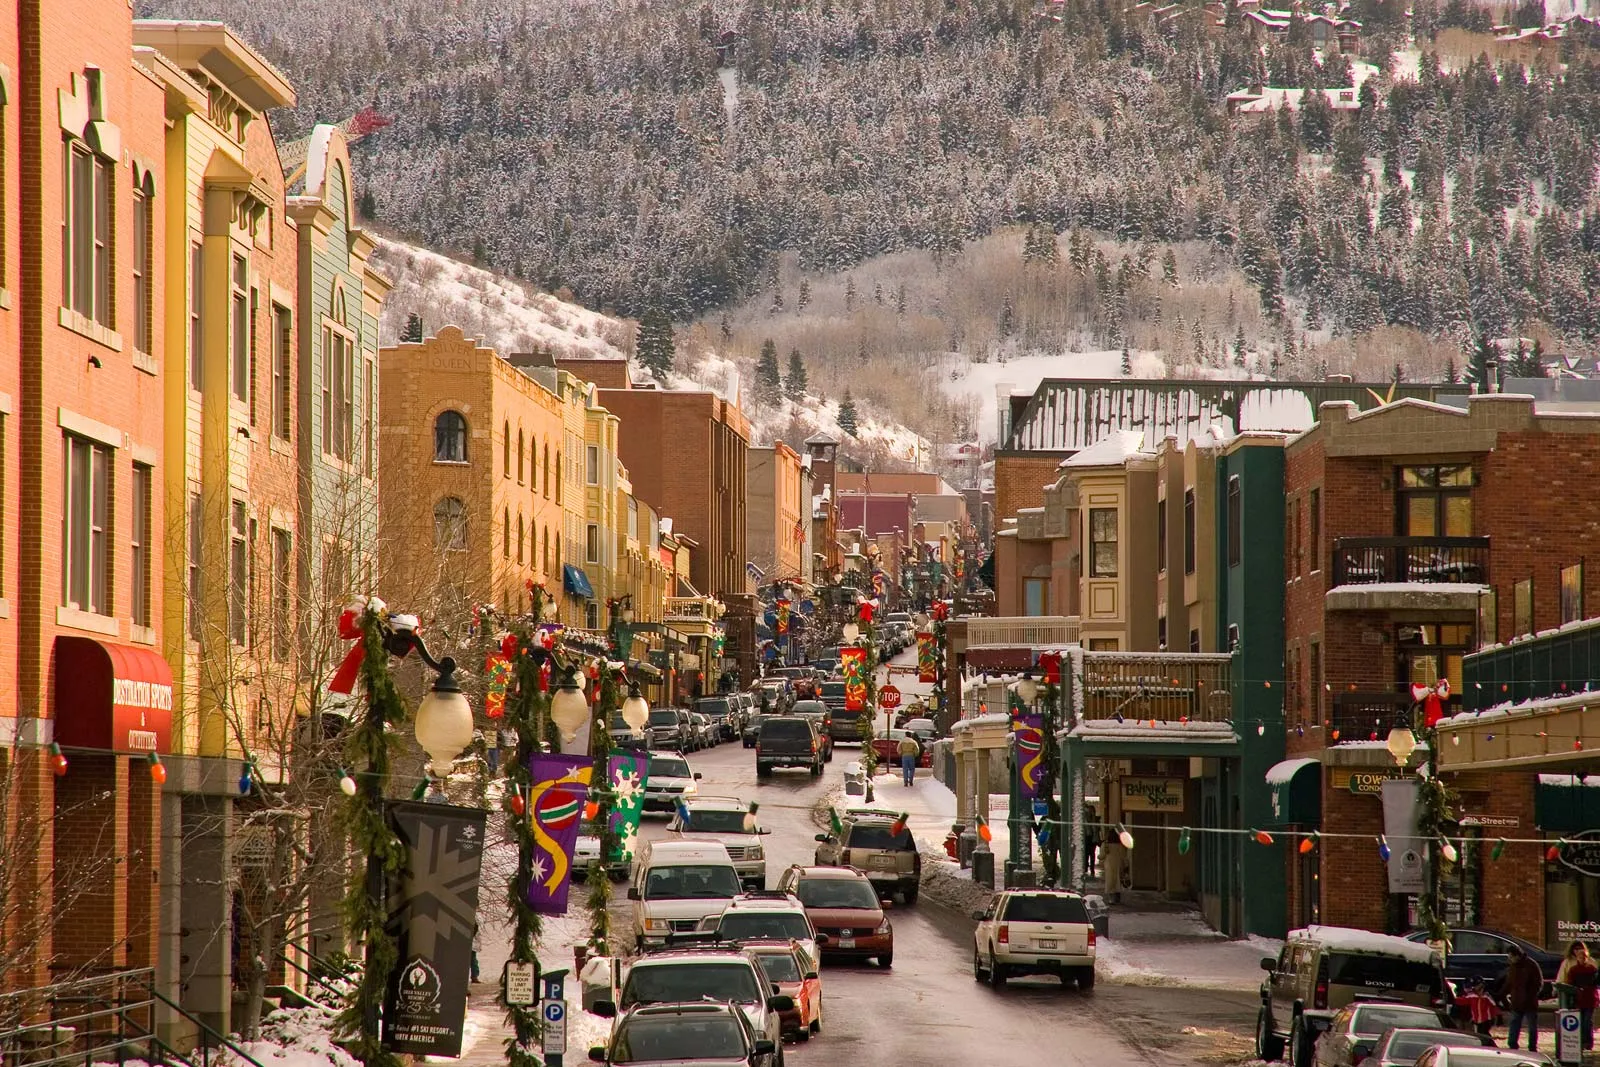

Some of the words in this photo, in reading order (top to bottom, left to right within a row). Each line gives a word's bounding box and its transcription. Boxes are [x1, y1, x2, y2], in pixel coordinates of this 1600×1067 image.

[433, 342, 470, 355] SILVER
[432, 358, 471, 369] QUEEN
[113, 678, 151, 708] DESTINATION
[151, 683, 172, 711] SPORTS
[141, 711, 145, 727] &
[128, 729, 157, 750] OUTFITTERS
[1480, 817, 1506, 825] Street
[550, 1006, 560, 1019] P
[420, 1025, 429, 1033] SKI
[429, 1026, 450, 1035] RESORT
[1566, 1017, 1576, 1030] P
[409, 1034, 435, 1043] AMERICA
